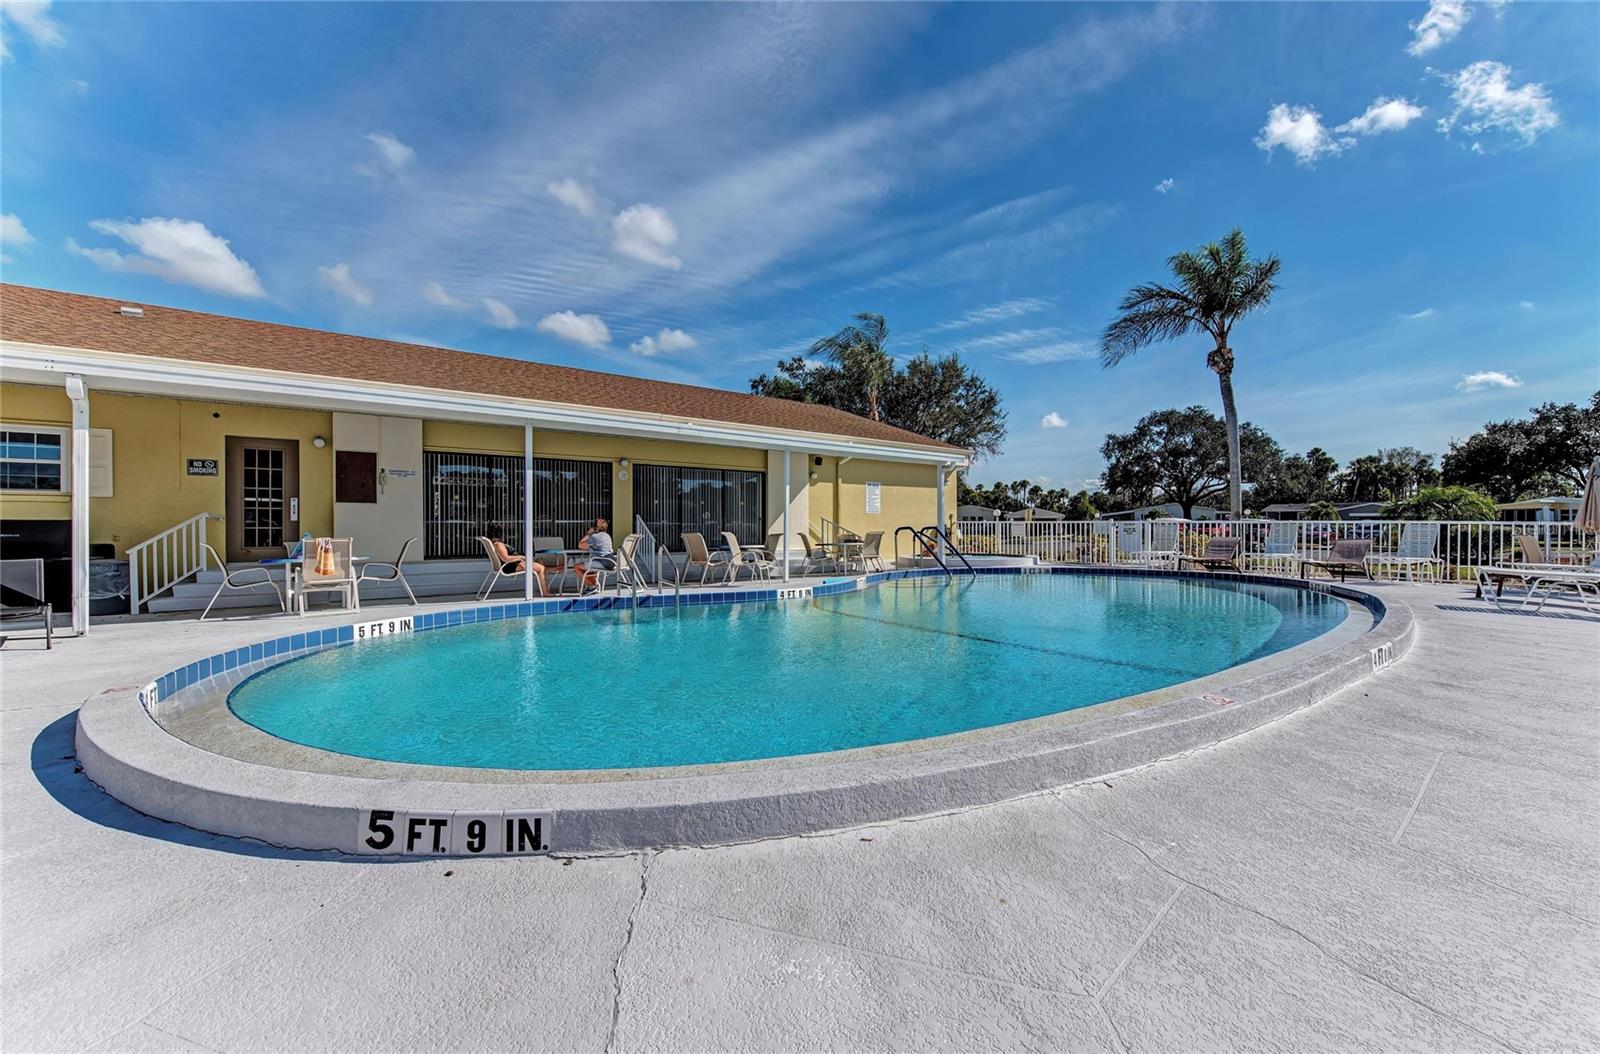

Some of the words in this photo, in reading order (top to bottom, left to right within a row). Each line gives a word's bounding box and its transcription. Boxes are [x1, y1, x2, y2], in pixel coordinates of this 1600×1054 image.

[358, 626, 366, 638] 5
[389, 621, 396, 633] 9
[365, 810, 395, 850] 5
[406, 818, 449, 853] FT.
[466, 819, 487, 853] 9
[506, 818, 549, 852] IN.
